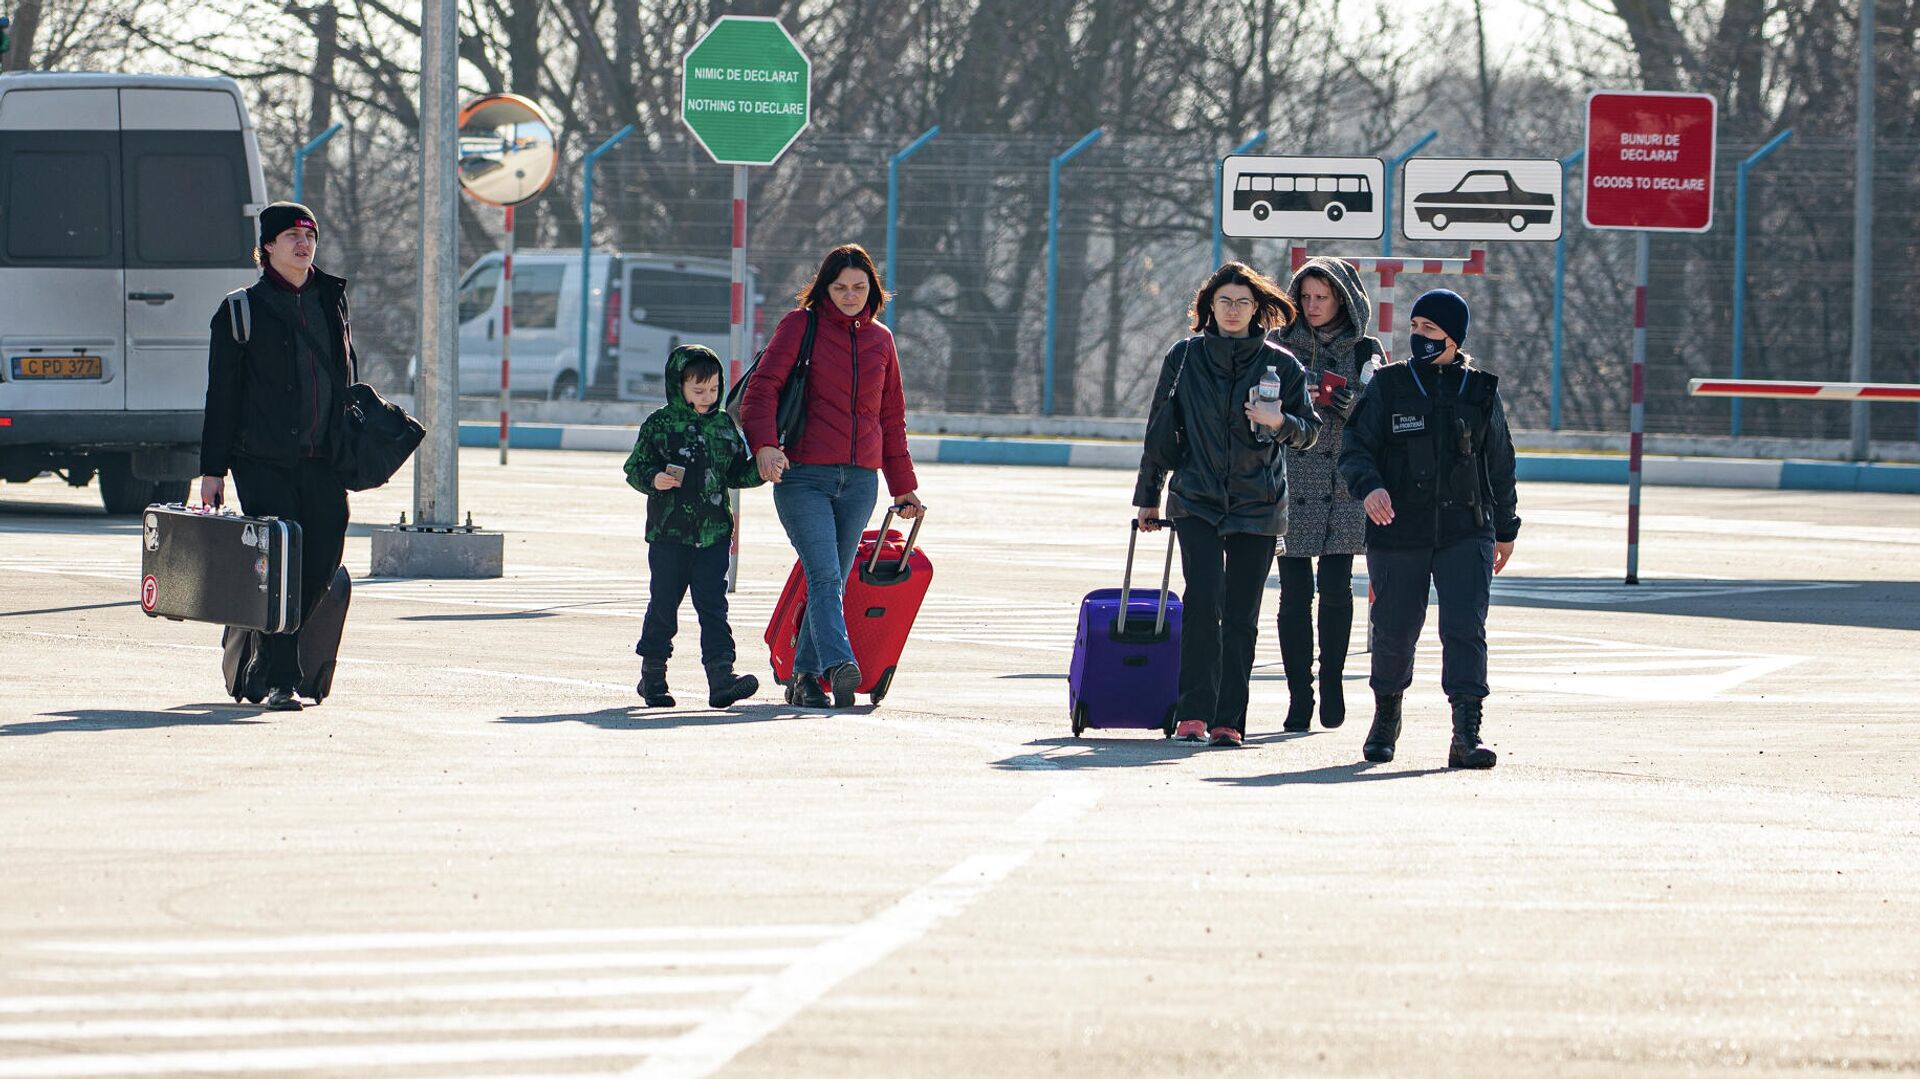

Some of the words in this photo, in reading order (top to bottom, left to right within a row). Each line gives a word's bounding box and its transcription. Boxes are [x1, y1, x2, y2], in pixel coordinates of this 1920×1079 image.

[694, 67, 724, 80] NIMIC
[727, 69, 741, 80] DE
[744, 70, 799, 82] DECLARAT
[687, 99, 735, 112] NOTHING
[738, 101, 752, 113] TO
[755, 102, 804, 115] DECLARE
[1620, 133, 1662, 145] BUNURI
[1664, 134, 1681, 146] DE
[1620, 149, 1679, 162] DECLARAT
[1593, 176, 1633, 188] GOODS
[1635, 177, 1651, 189] TO
[1653, 178, 1705, 191] DECLARE
[28, 360, 38, 374] C
[68, 360, 96, 373] 377
